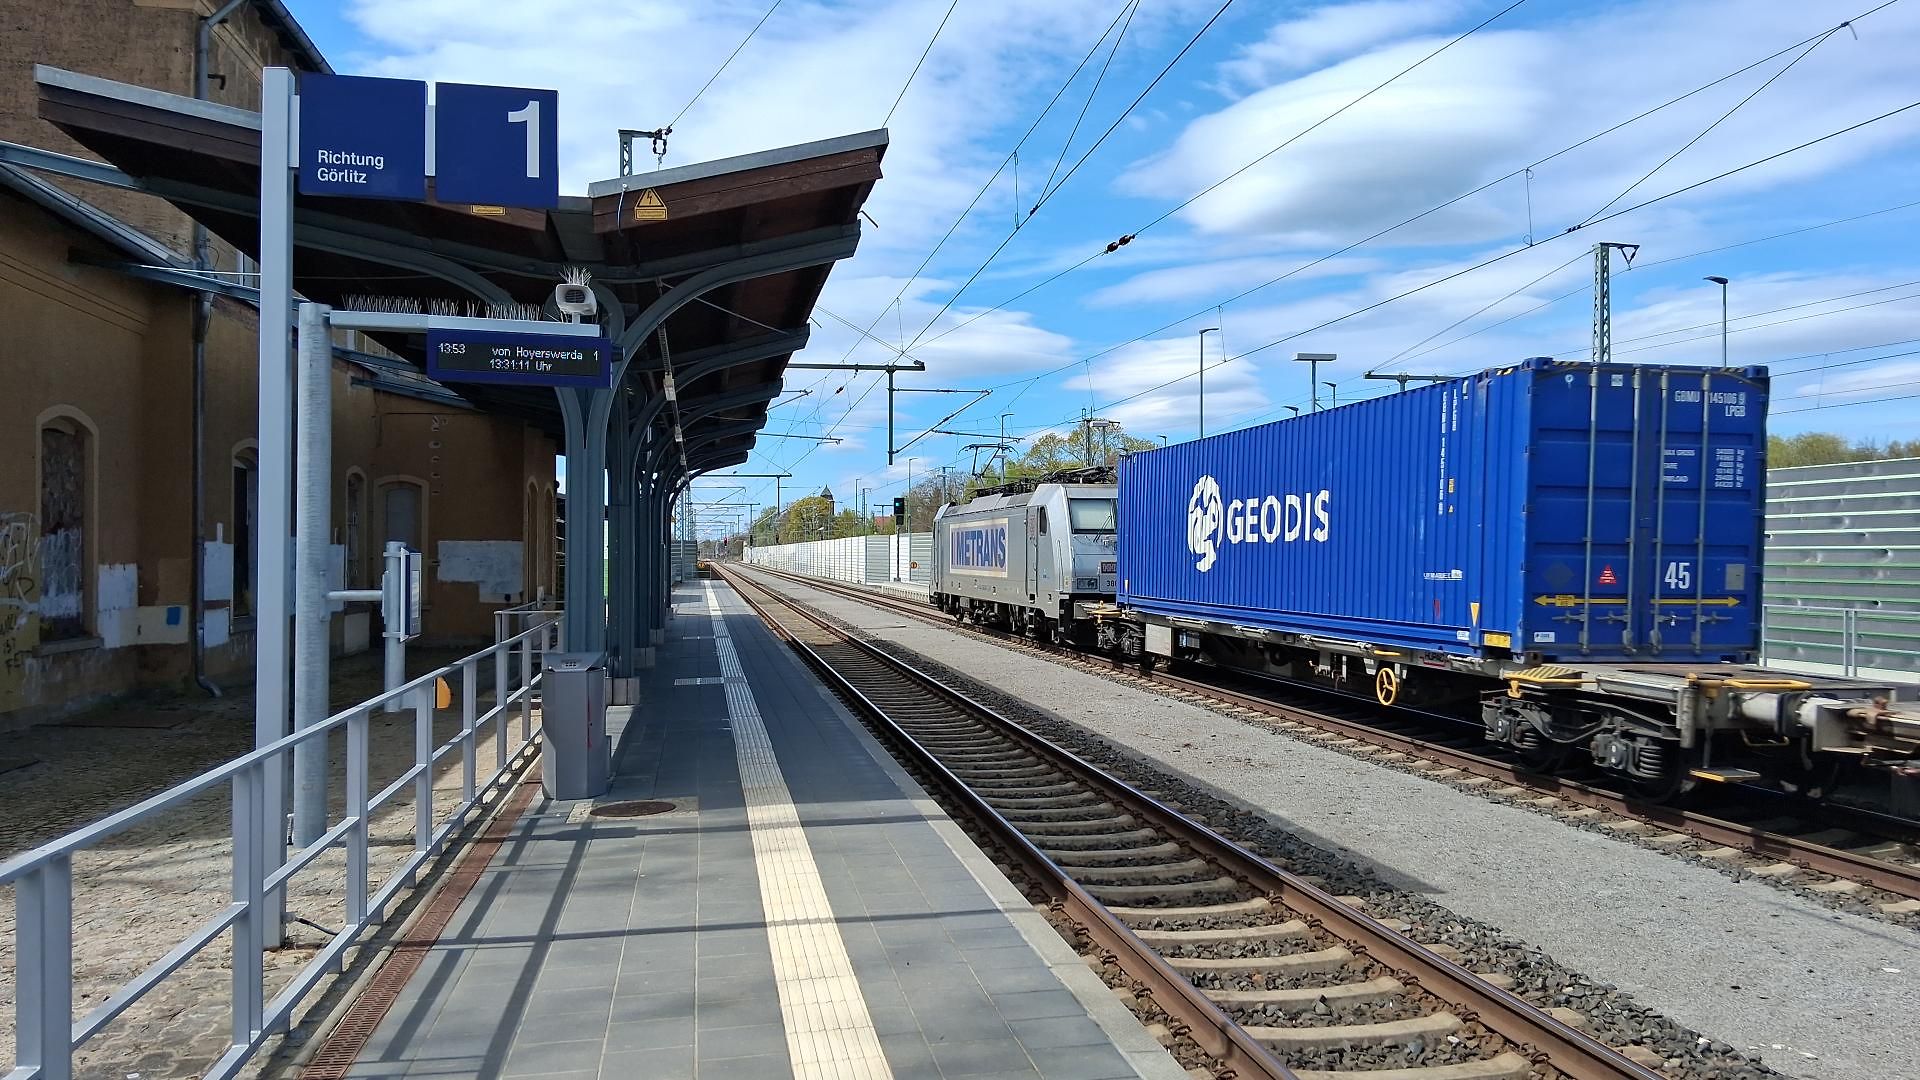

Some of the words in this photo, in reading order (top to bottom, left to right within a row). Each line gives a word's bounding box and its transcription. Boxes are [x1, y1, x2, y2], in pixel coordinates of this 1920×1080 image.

[508, 100, 540, 178] 1
[318, 149, 384, 170] Richtung
[317, 167, 367, 184] Görlitz
[438, 342, 466, 354] 13:53
[492, 347, 511, 357] von
[516, 346, 583, 360] Hoyerswerda
[593, 350, 599, 361] 1
[489, 358, 530, 371] 13:31:11
[535, 360, 553, 372] Uhr
[1227, 489, 1329, 544] GEODIS
[956, 527, 1006, 569] METRANS
[1664, 561, 1691, 590] 45
